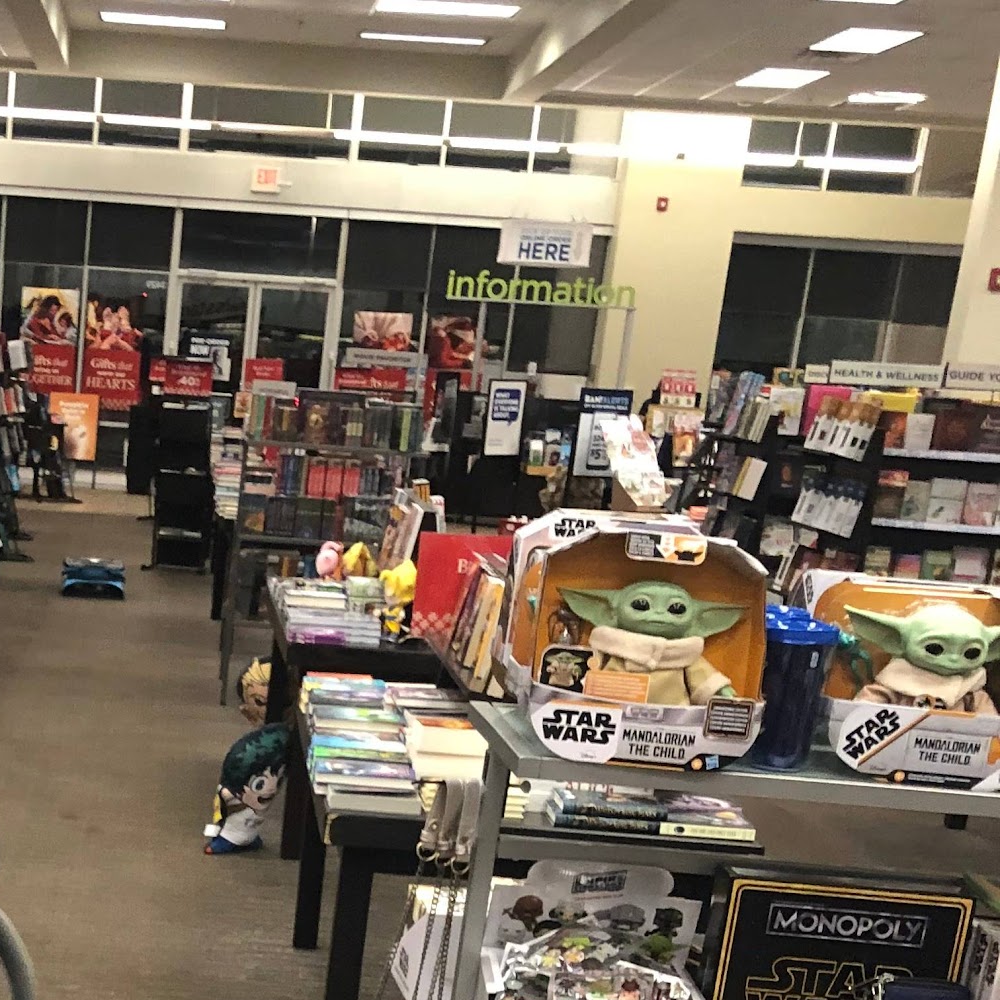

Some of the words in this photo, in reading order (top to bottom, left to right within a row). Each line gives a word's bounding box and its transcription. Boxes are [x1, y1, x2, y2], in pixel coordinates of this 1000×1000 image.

[518, 242, 571, 262] HERE
[446, 269, 636, 305] information
[85, 376, 136, 391] HEARTS
[834, 369, 873, 378] HEALTH
[875, 370, 883, 379] &
[885, 371, 939, 382] WELLNESS
[949, 371, 985, 380] GUIDE
[555, 518, 597, 530] STAR
[542, 709, 616, 728] STAR
[542, 724, 616, 745] WARS
[622, 728, 696, 747] MANDALORIAN
[843, 709, 898, 750] STAR
[846, 716, 902, 760] WARS
[629, 743, 651, 757] THE
[653, 745, 685, 760] CHILD
[914, 738, 981, 754] MANDALORIAN
[919, 751, 938, 762] THE
[941, 753, 971, 766] CHILD
[773, 910, 922, 941] MONOPOLY
[745, 957, 914, 998] STA
